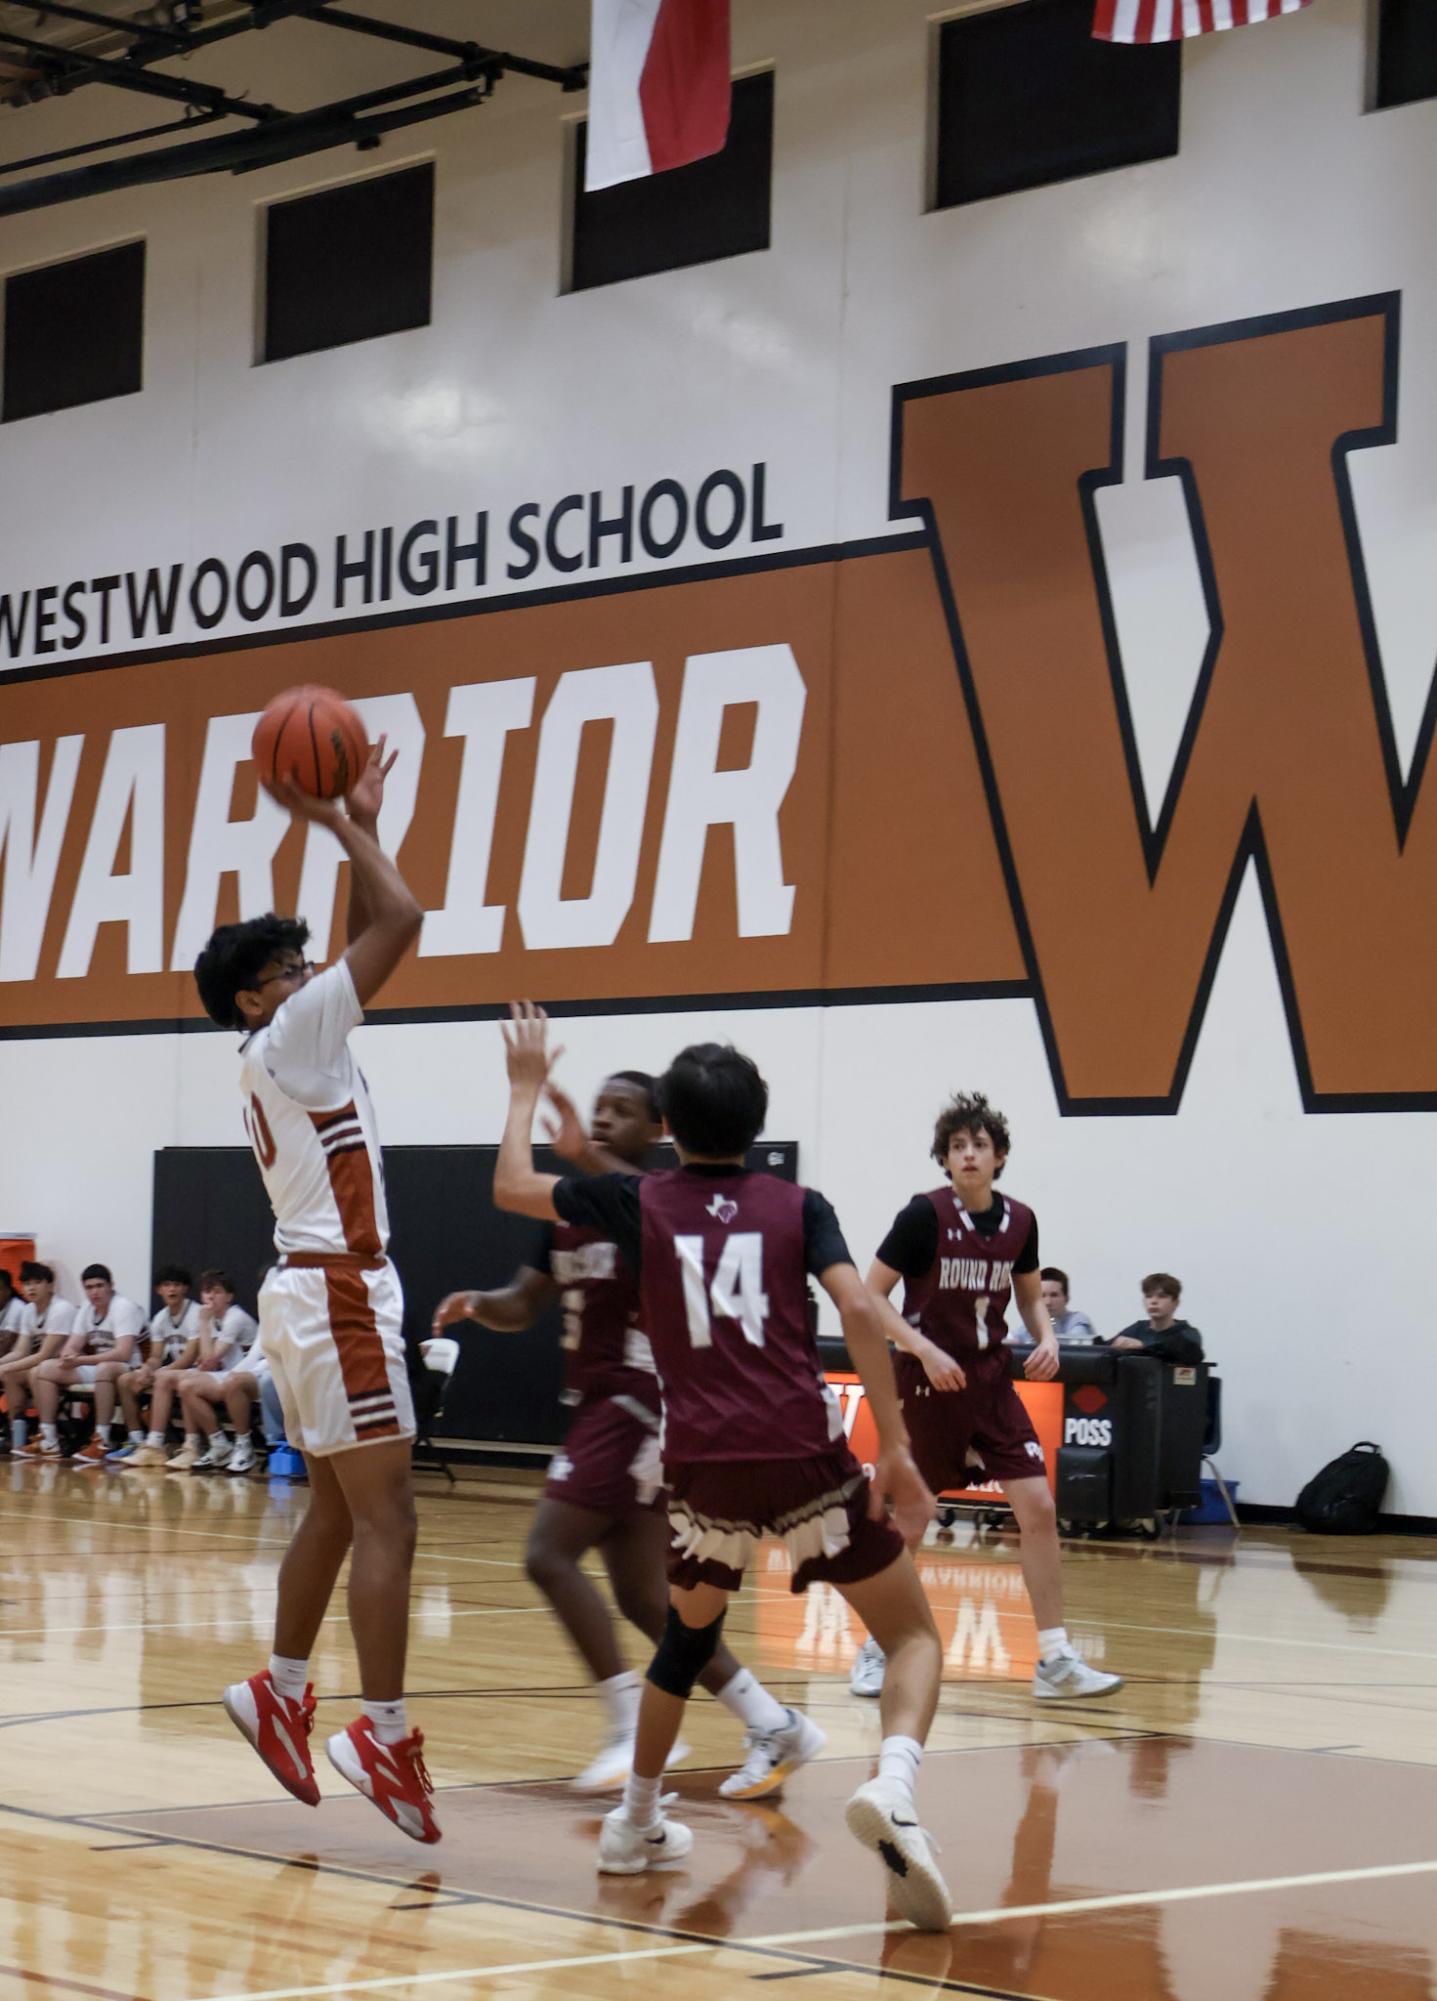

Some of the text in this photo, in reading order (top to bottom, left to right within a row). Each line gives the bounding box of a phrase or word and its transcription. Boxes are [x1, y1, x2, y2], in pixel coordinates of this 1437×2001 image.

[0, 461, 784, 659] WESTWOOD HIGH SCHOOL
[888, 290, 1437, 1117] W
[673, 1232, 769, 1348] 14
[939, 1257, 988, 1291] ROUND
[974, 1296, 991, 1350] 1
[1065, 1418, 1112, 1446] POSS
